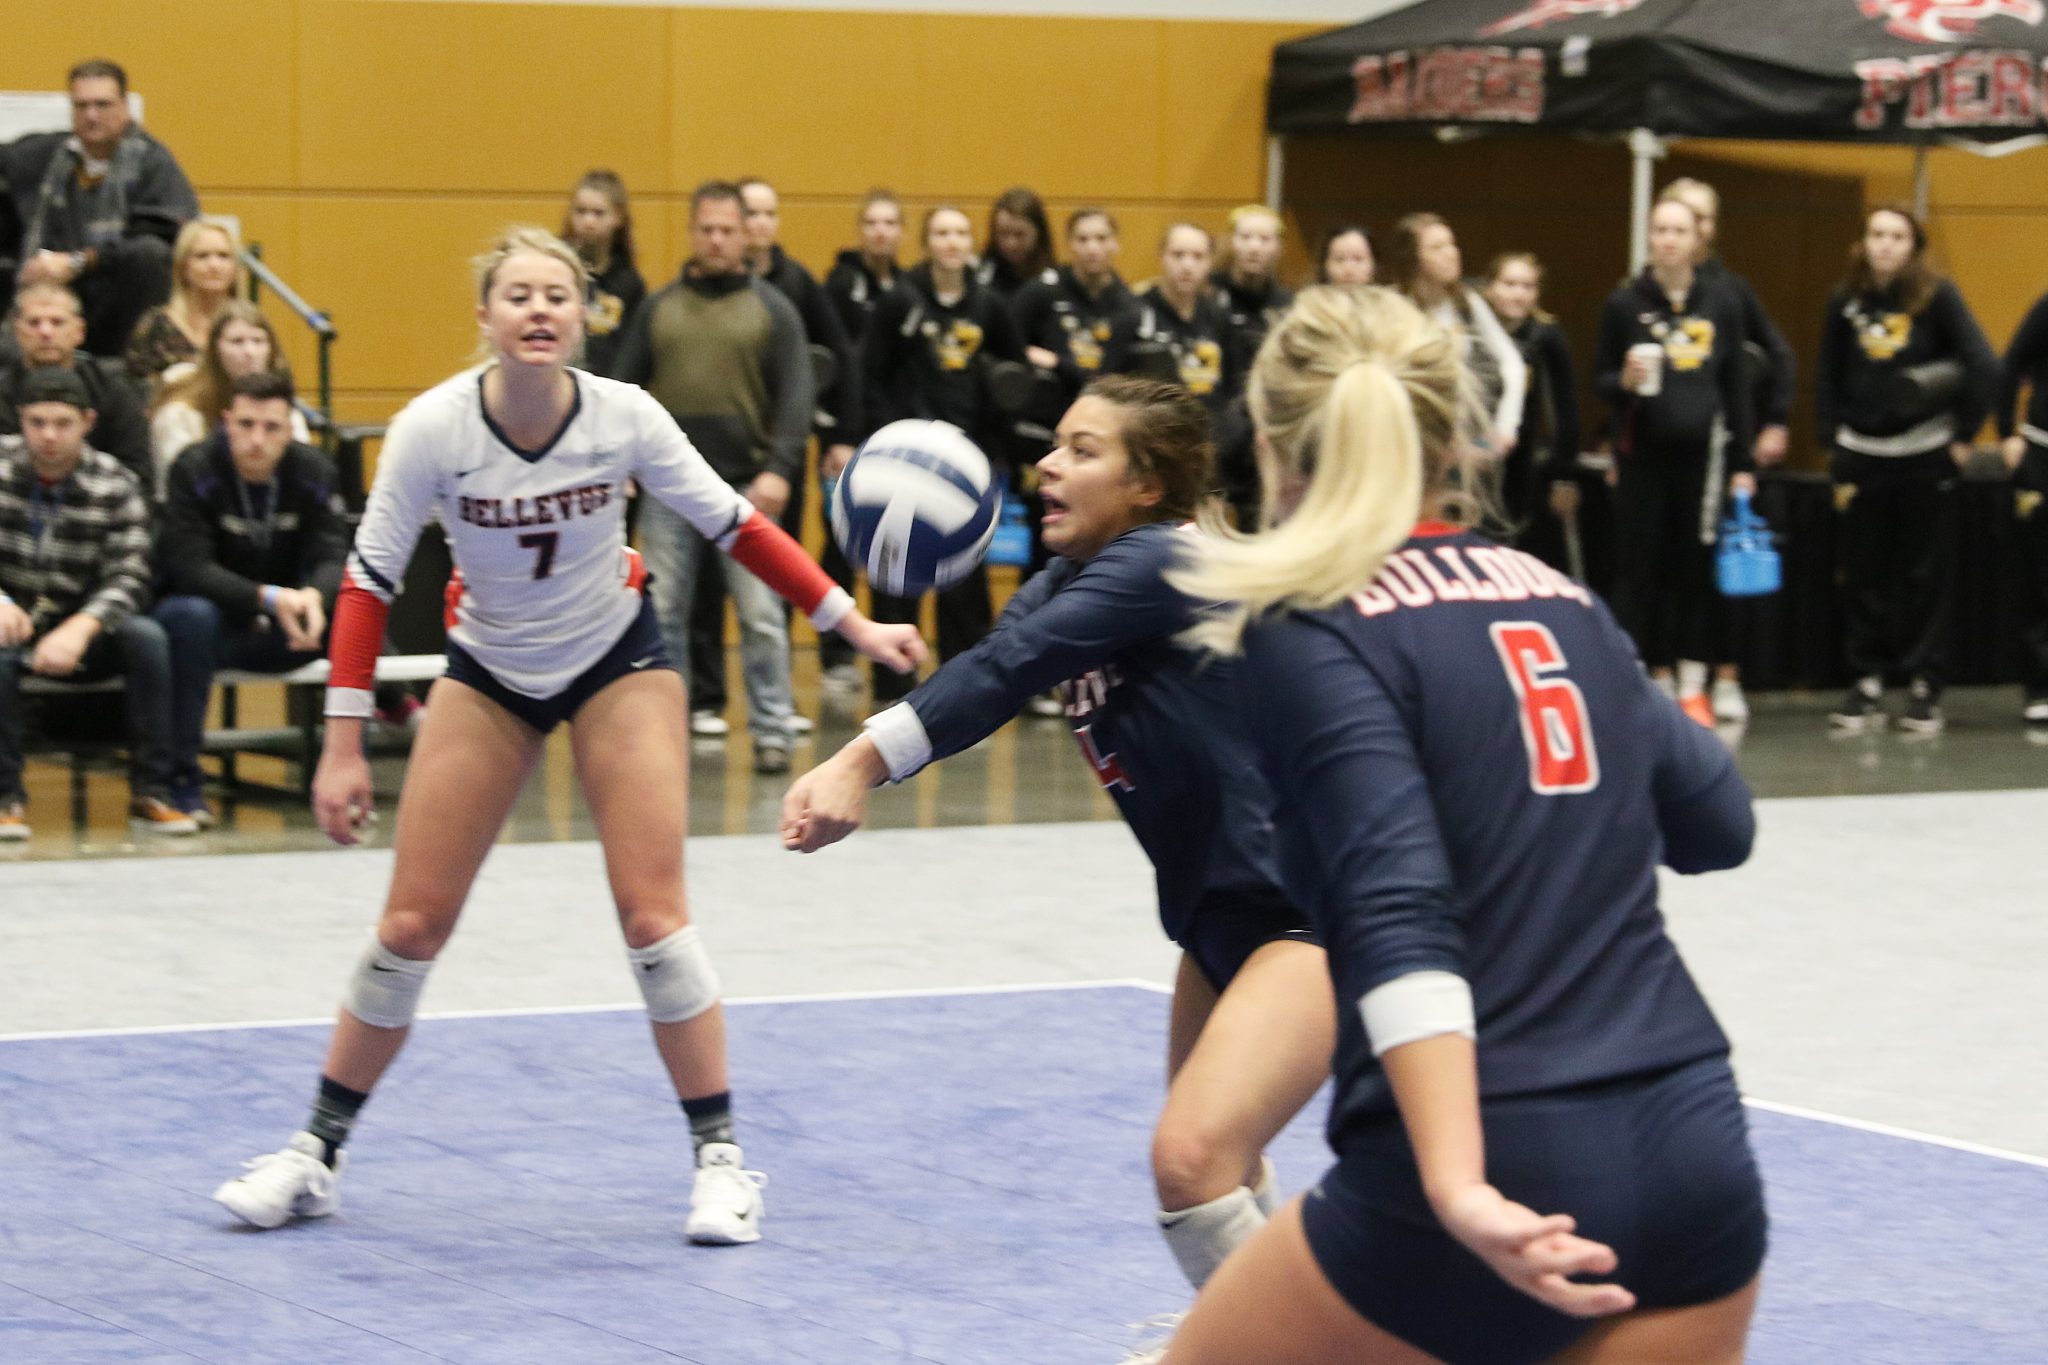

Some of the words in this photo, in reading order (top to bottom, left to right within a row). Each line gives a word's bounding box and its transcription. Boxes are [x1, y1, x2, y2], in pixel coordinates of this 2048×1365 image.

[1855, 50, 2048, 129] PIER
[517, 532, 559, 580] 7
[1489, 621, 1599, 795] 6
